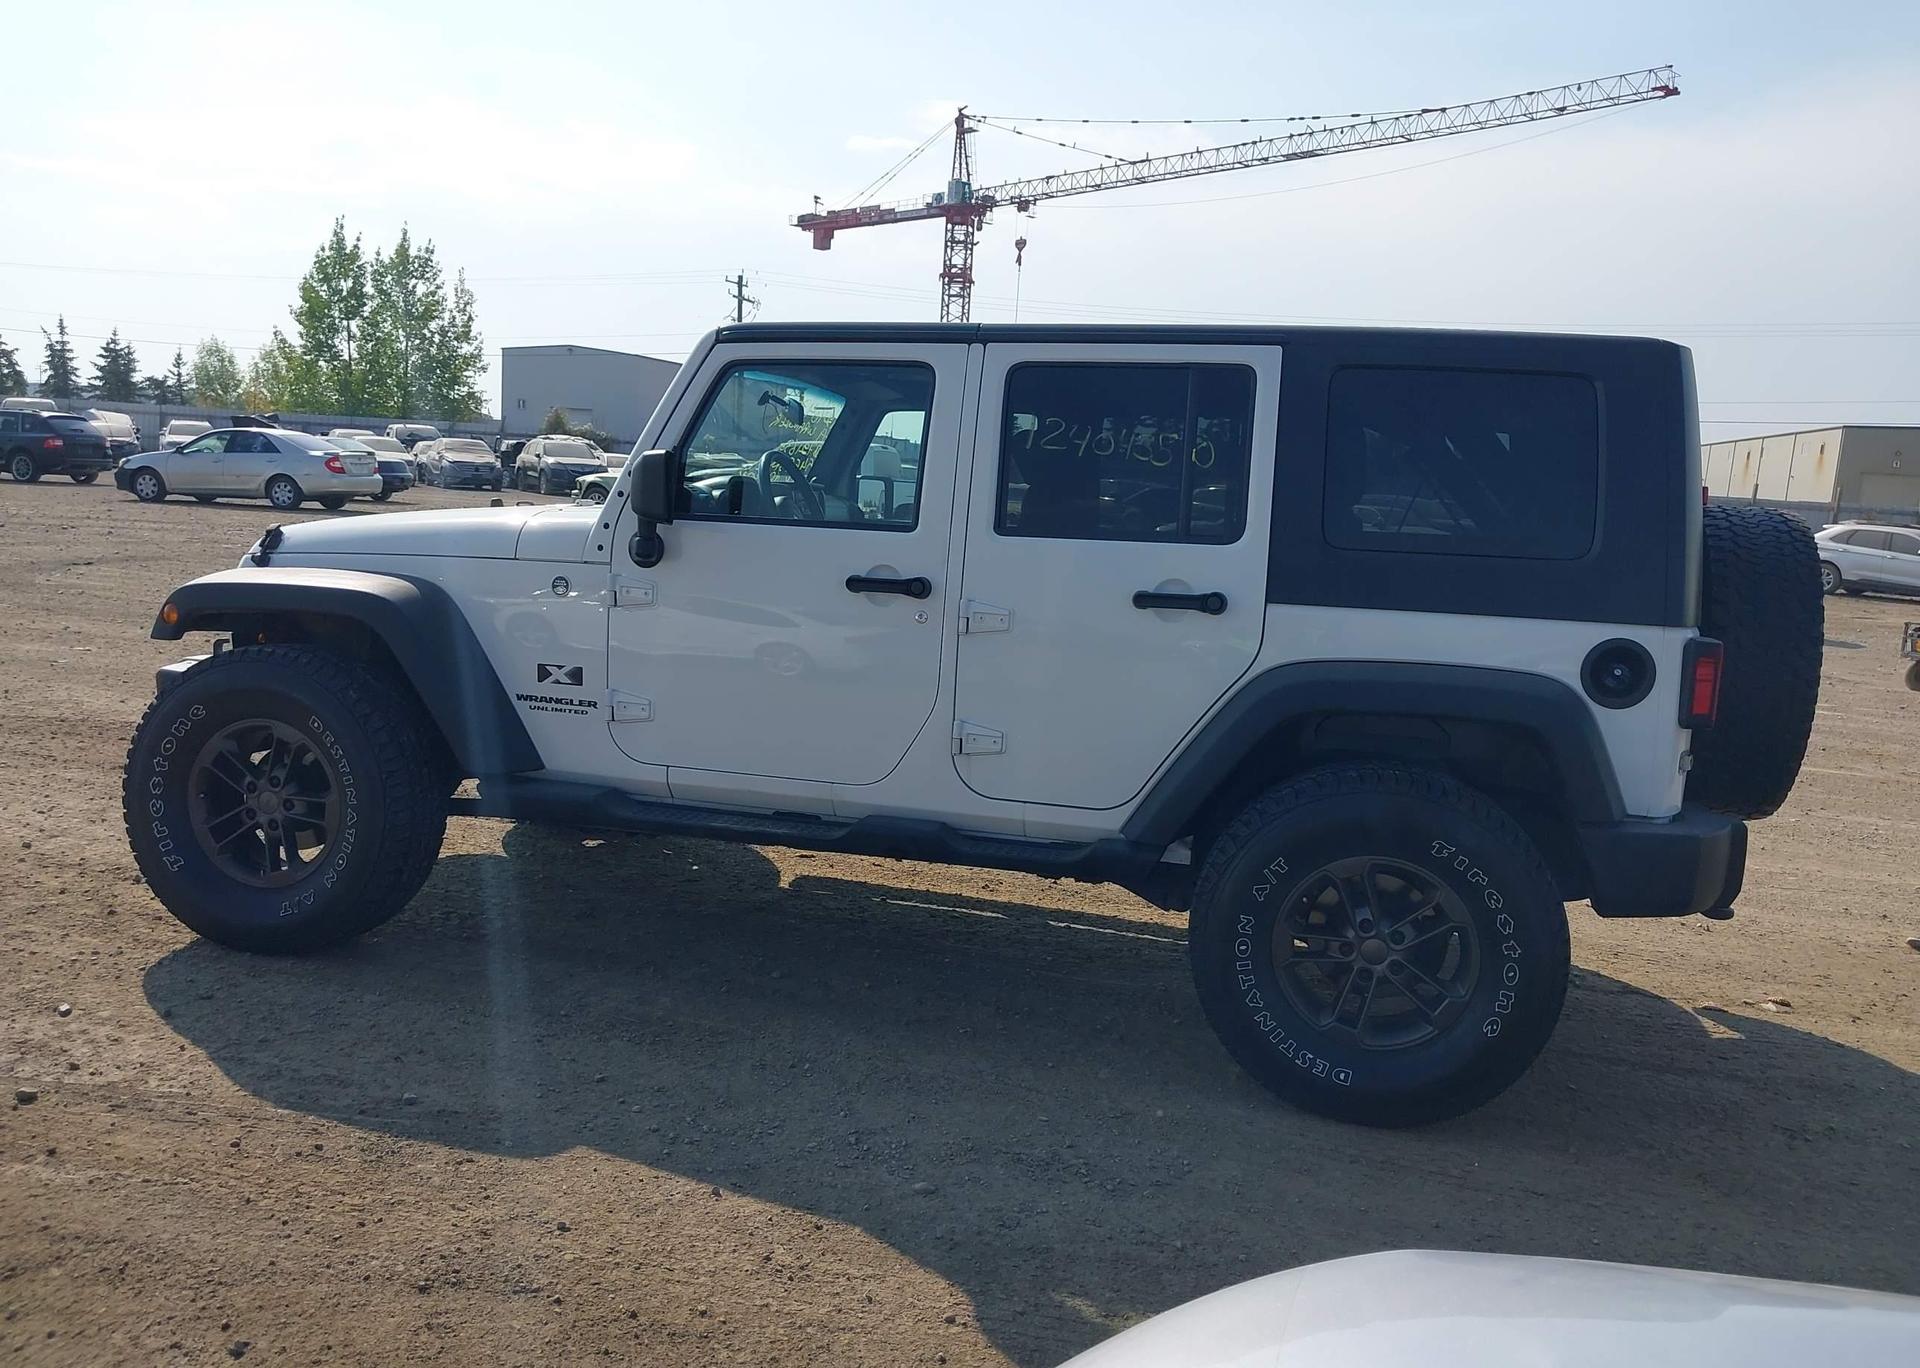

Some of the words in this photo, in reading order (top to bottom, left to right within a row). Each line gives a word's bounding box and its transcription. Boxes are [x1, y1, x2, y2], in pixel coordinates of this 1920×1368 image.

[515, 693, 599, 710] WRANGLER
[528, 704, 589, 716] UNLIMITED
[308, 715, 358, 888] DESTINATION
[1252, 857, 1289, 902] A/T
[1235, 914, 1353, 1087] DESTINATION
